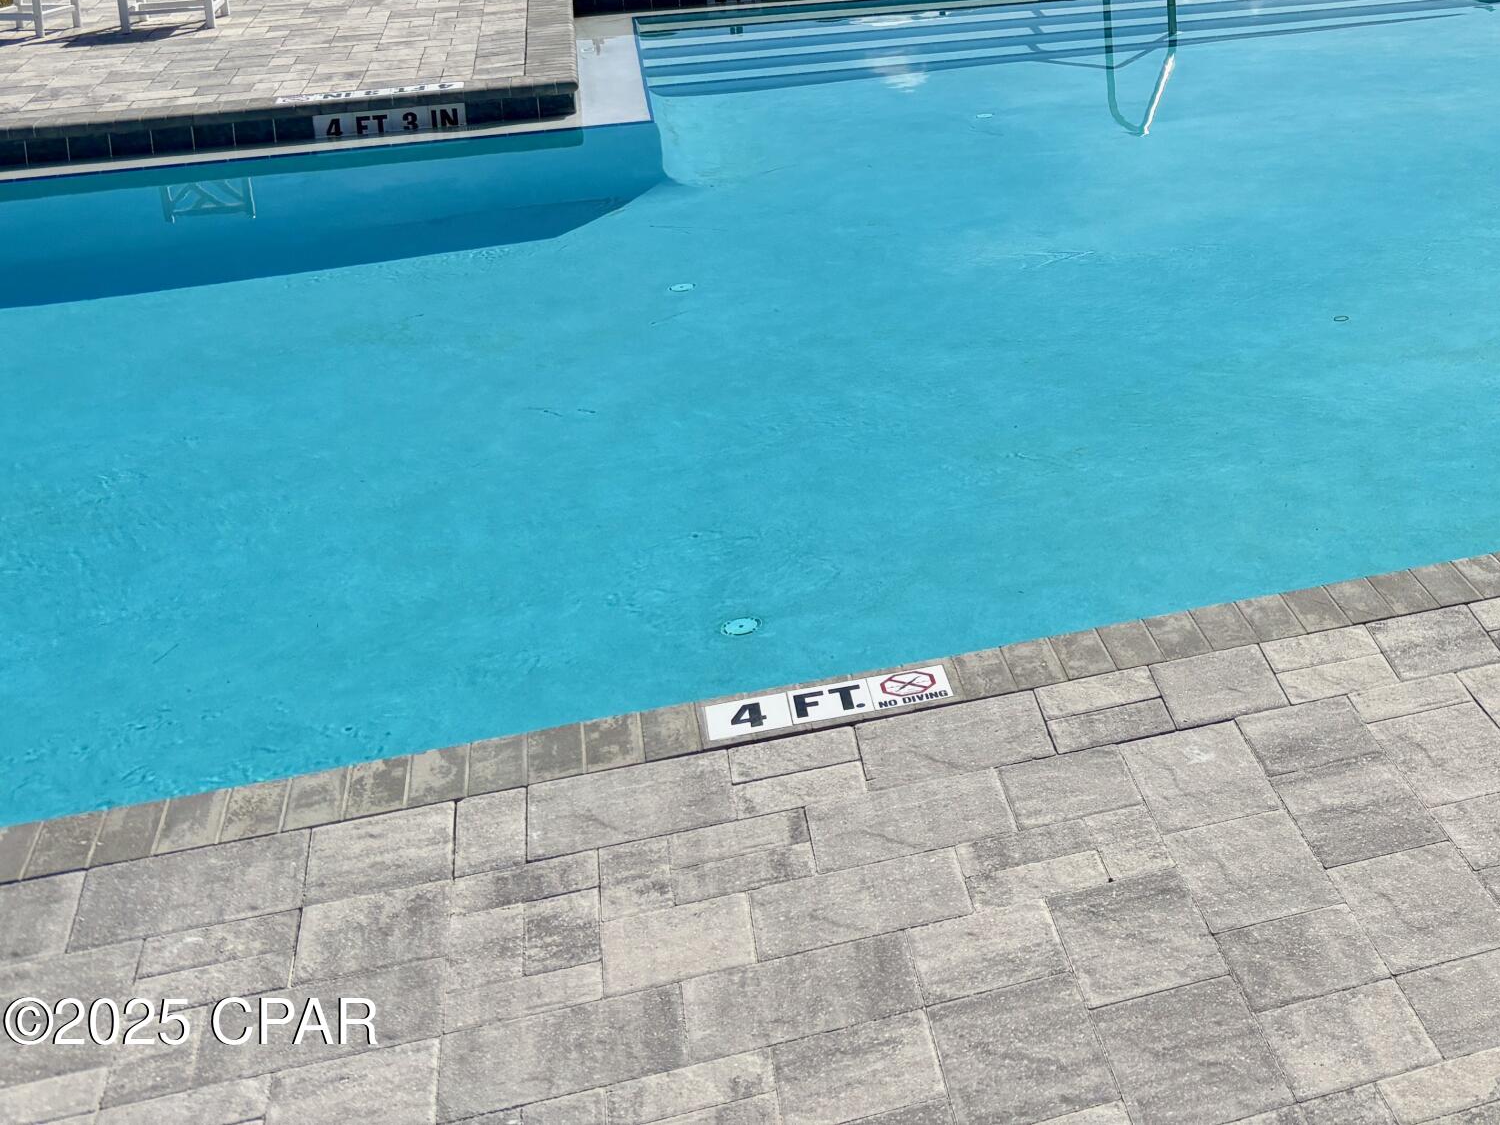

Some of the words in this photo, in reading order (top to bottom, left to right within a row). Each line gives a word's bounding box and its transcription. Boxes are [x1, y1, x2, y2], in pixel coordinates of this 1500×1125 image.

[326, 117, 343, 137] 4
[355, 114, 388, 135] FT
[402, 112, 419, 130] 3
[430, 108, 459, 128] IN
[730, 701, 768, 728] 4
[792, 683, 866, 719] FT.
[878, 699, 898, 708] NO
[902, 689, 949, 704] DIVING
